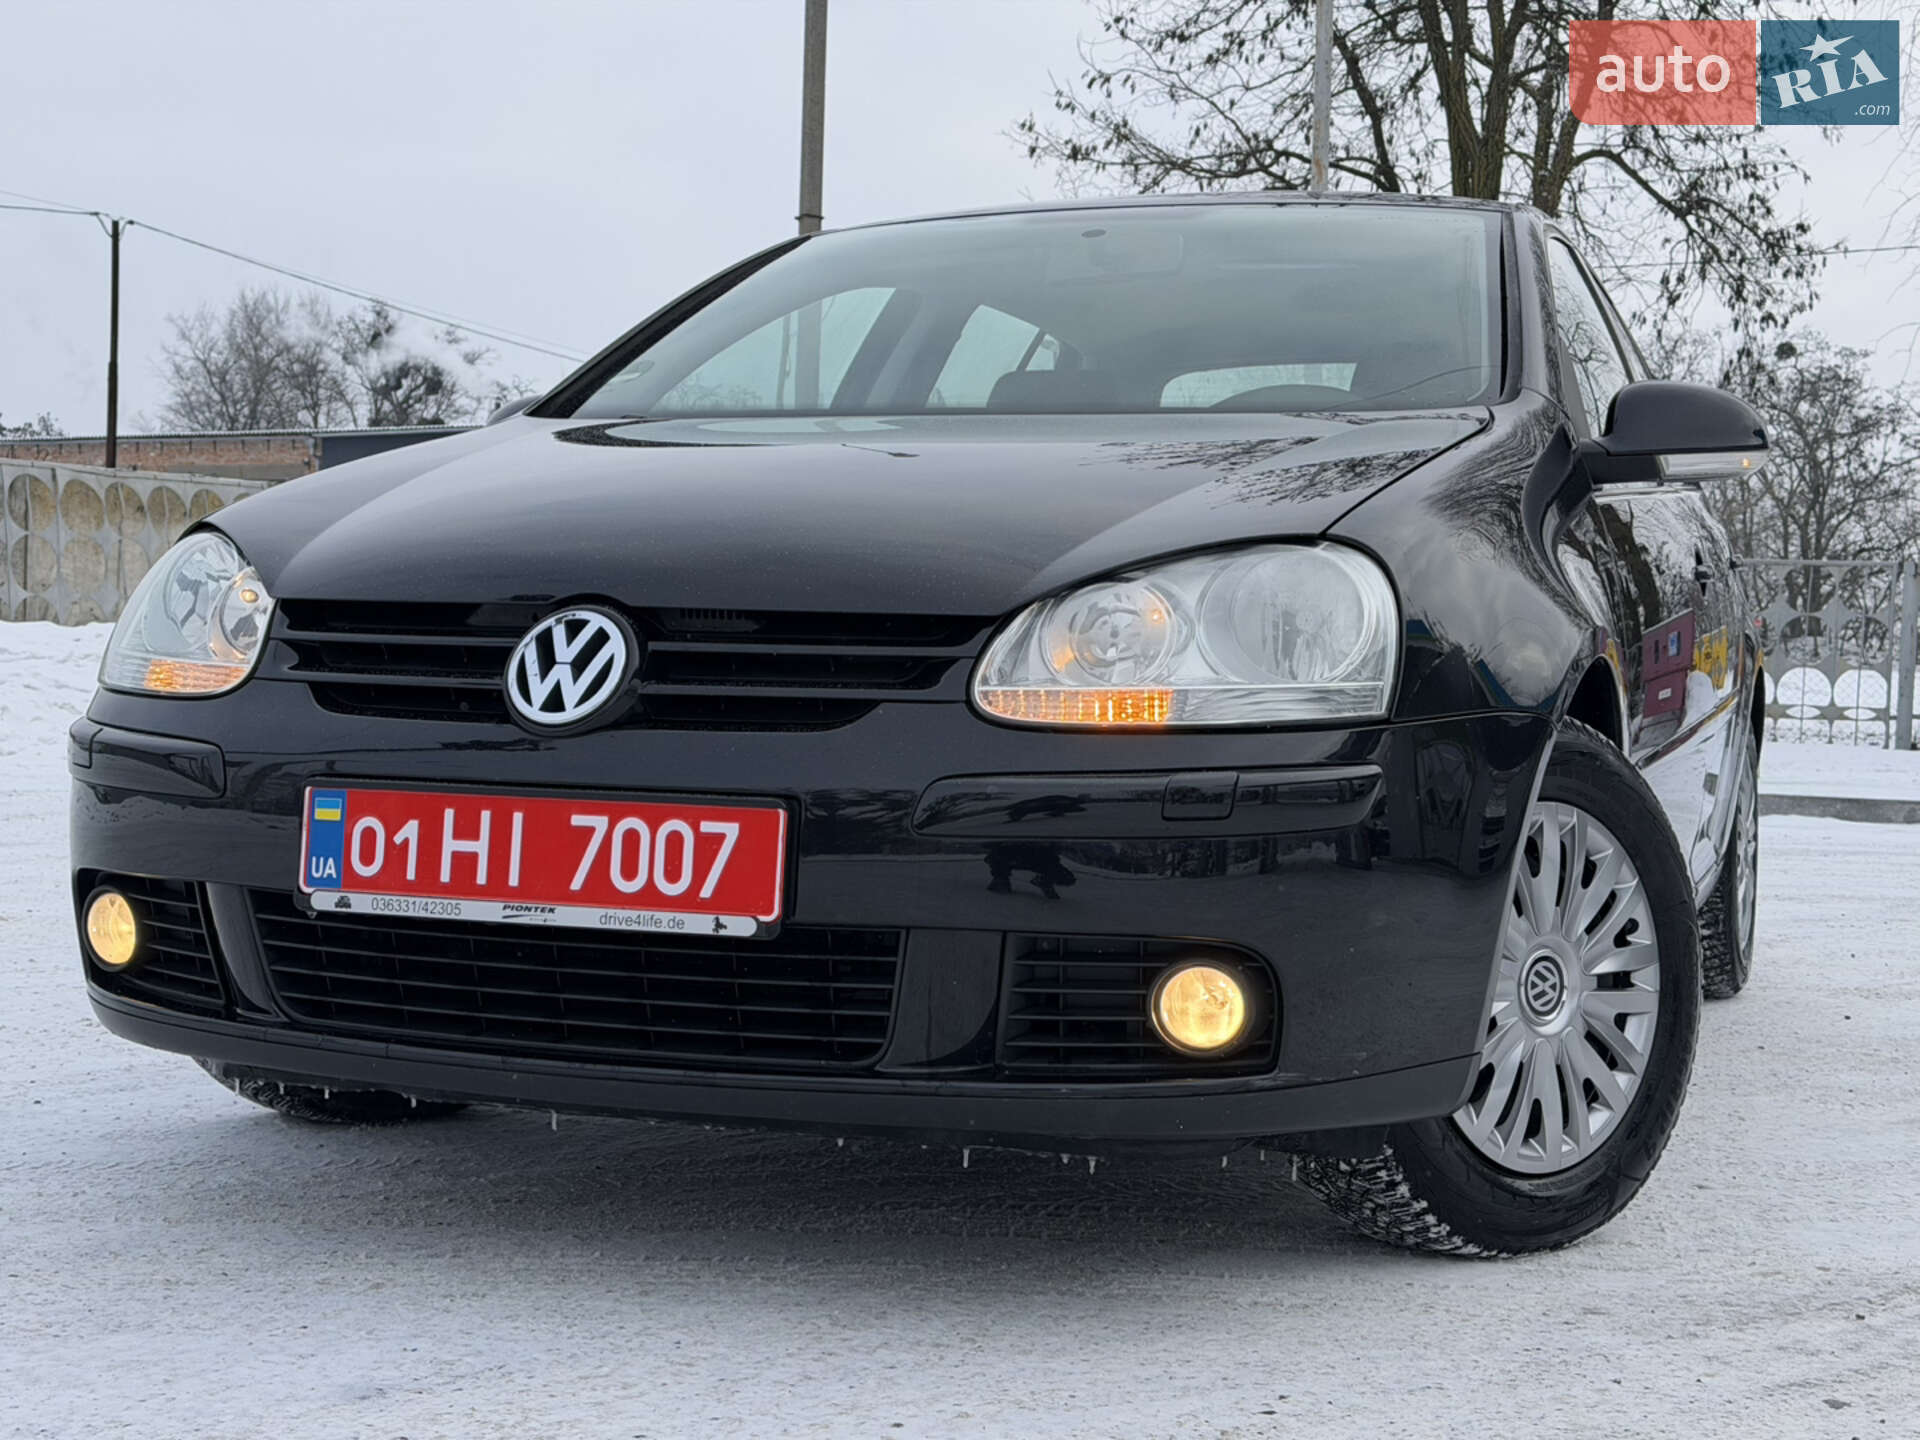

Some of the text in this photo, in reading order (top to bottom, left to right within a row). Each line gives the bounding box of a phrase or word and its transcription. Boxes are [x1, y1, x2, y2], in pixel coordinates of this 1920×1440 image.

[569, 815, 740, 899] 7007
[312, 856, 337, 879] UA
[371, 897, 462, 916] 036331/42305
[502, 904, 557, 914] PIONTEK
[599, 911, 685, 930] drive4life.de
